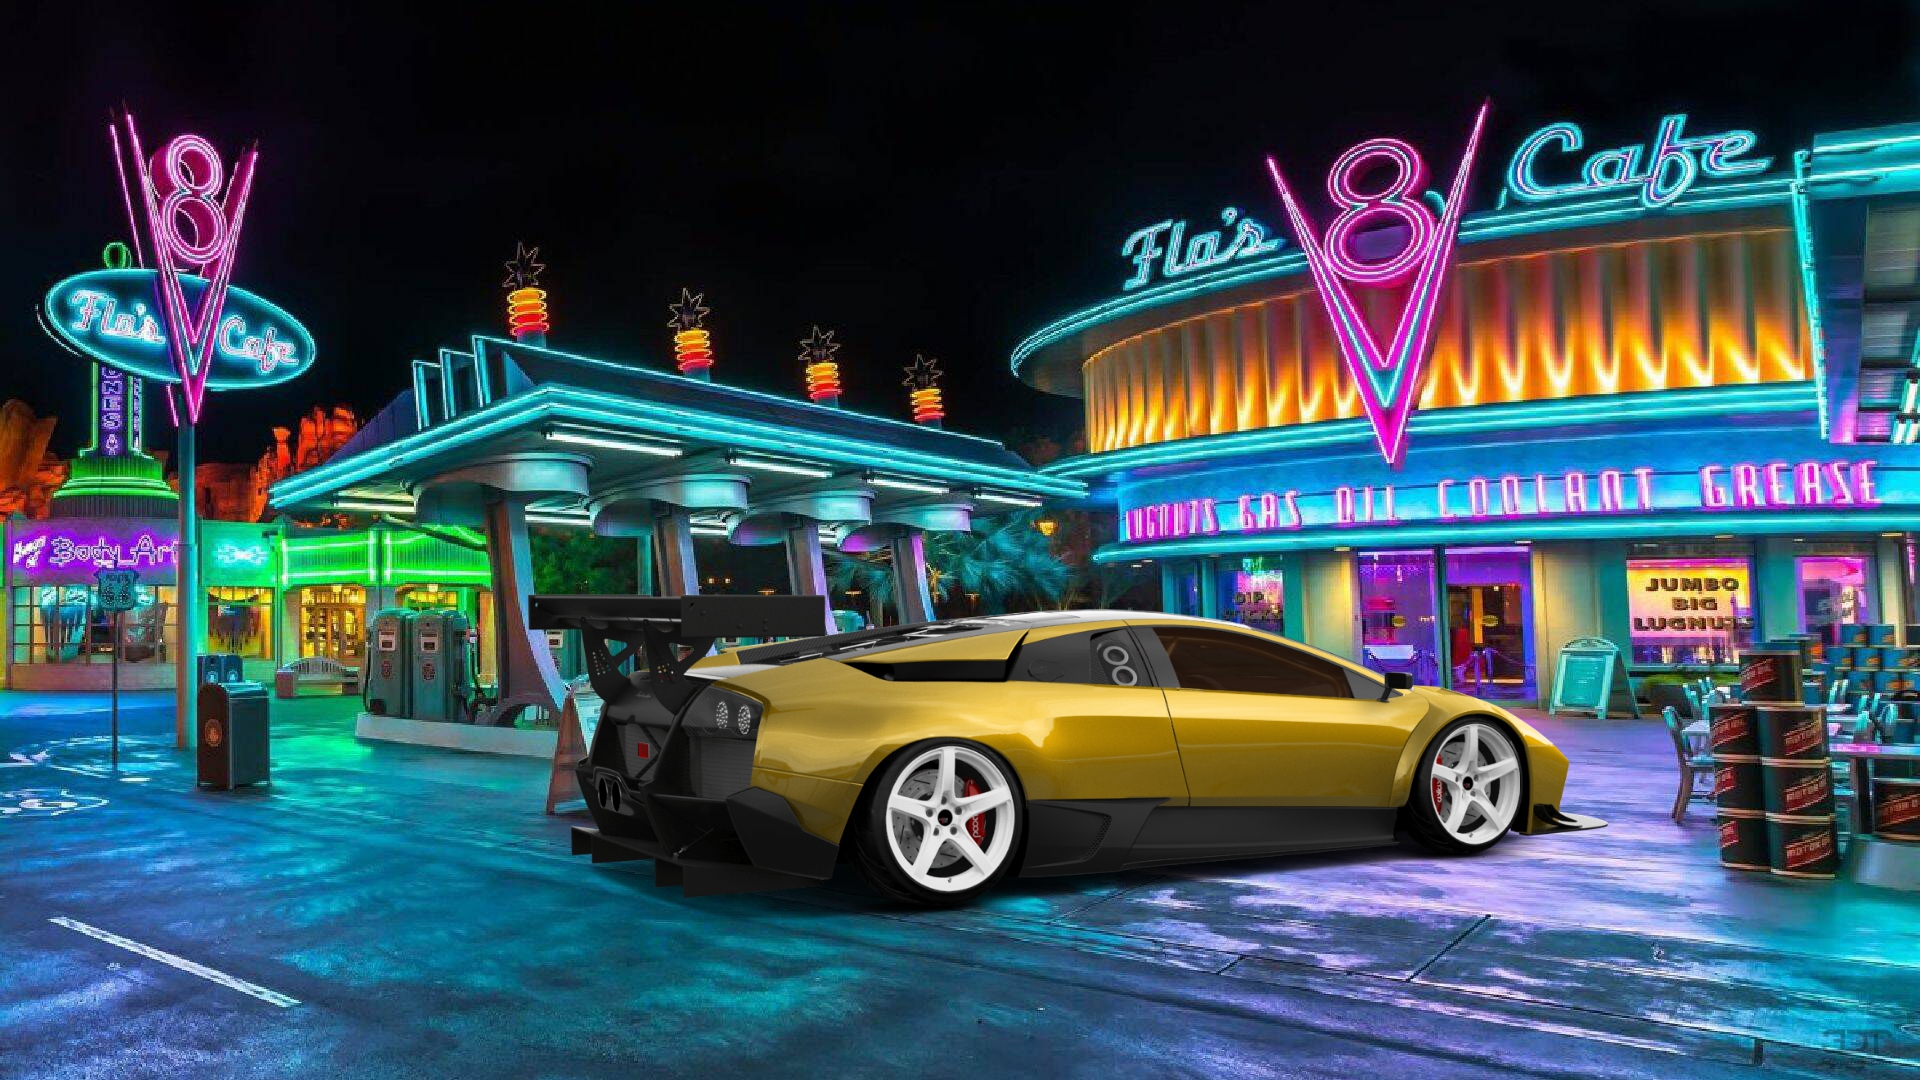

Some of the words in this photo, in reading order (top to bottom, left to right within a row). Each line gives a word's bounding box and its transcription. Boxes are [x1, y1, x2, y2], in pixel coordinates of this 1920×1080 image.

[1122, 207, 1286, 290] Flo's
[1508, 114, 1774, 208] Cafe
[72, 290, 165, 343] Flo's
[219, 315, 299, 373] Cafe
[1125, 498, 1219, 540] LUGNUTS
[1239, 490, 1302, 528] GAS
[1335, 485, 1399, 522] OIL
[1438, 468, 1654, 518] COOLANT
[1700, 461, 1880, 508] GREASE
[1645, 577, 1740, 592] JUMBO
[1671, 597, 1718, 611] BIG
[1633, 616, 1754, 631] LUGNUTS
